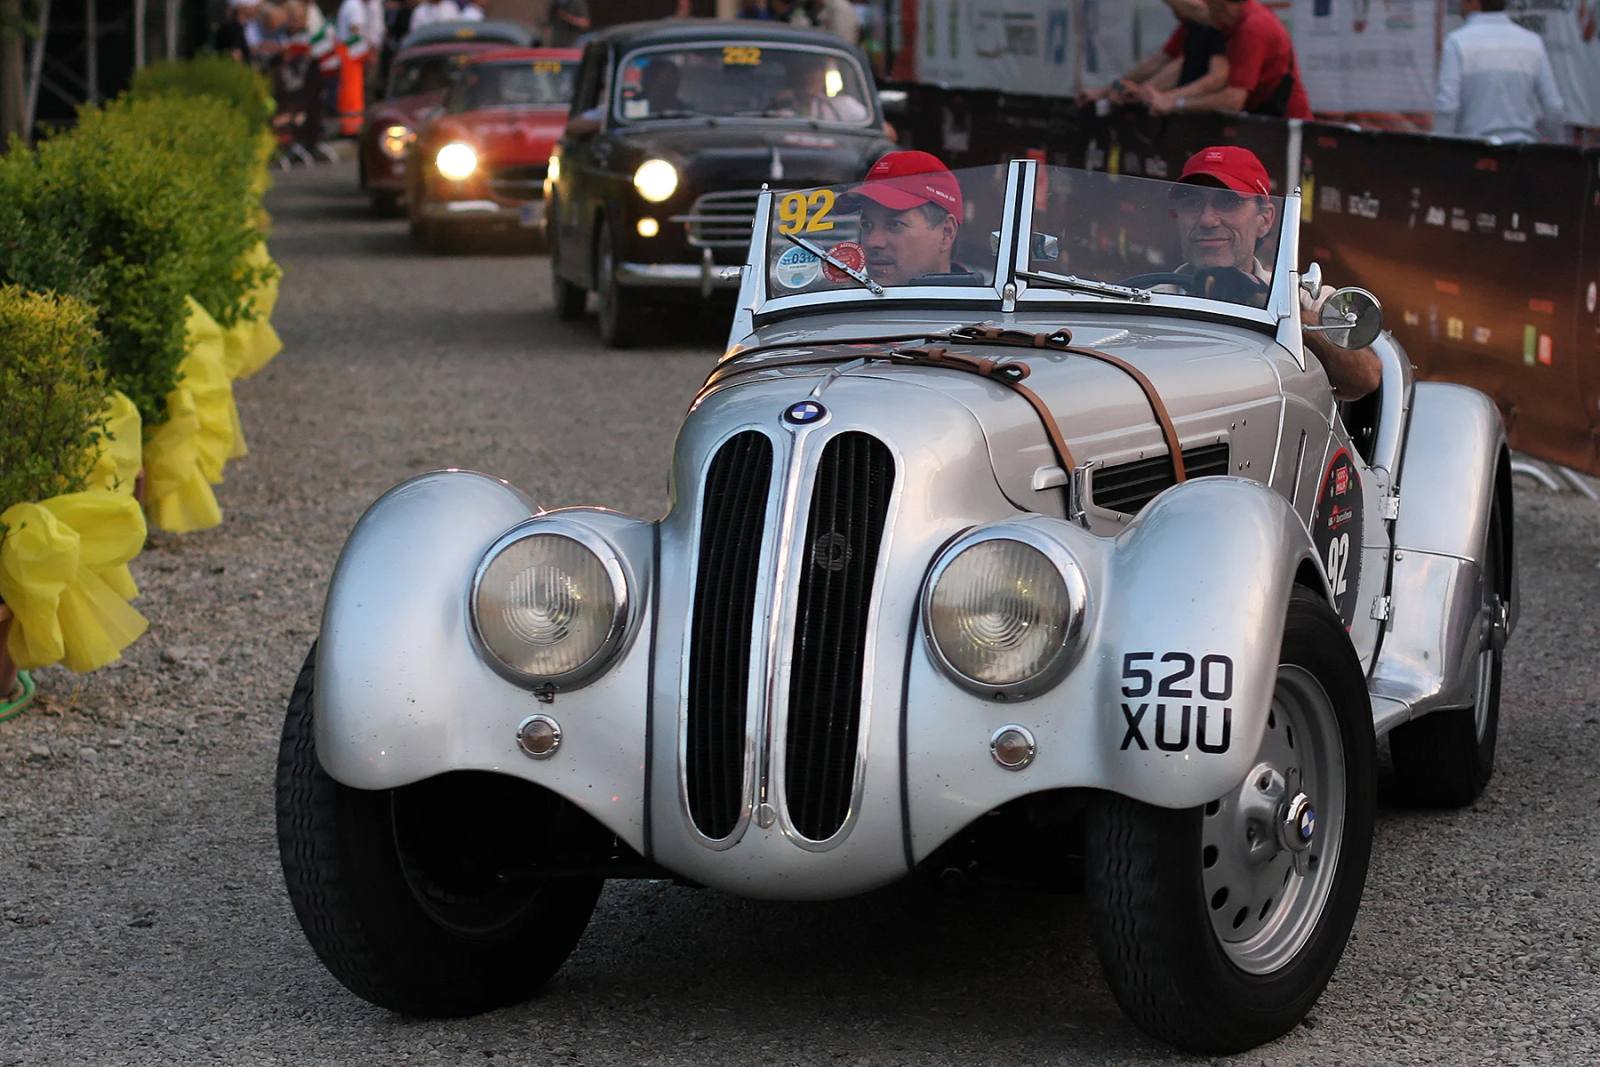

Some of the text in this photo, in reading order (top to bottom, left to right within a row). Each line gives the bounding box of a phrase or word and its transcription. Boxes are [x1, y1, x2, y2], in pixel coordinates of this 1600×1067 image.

[778, 189, 835, 235] 92
[1327, 532, 1350, 597] 92
[1121, 652, 1233, 701] 520
[1120, 703, 1233, 754] XUU
